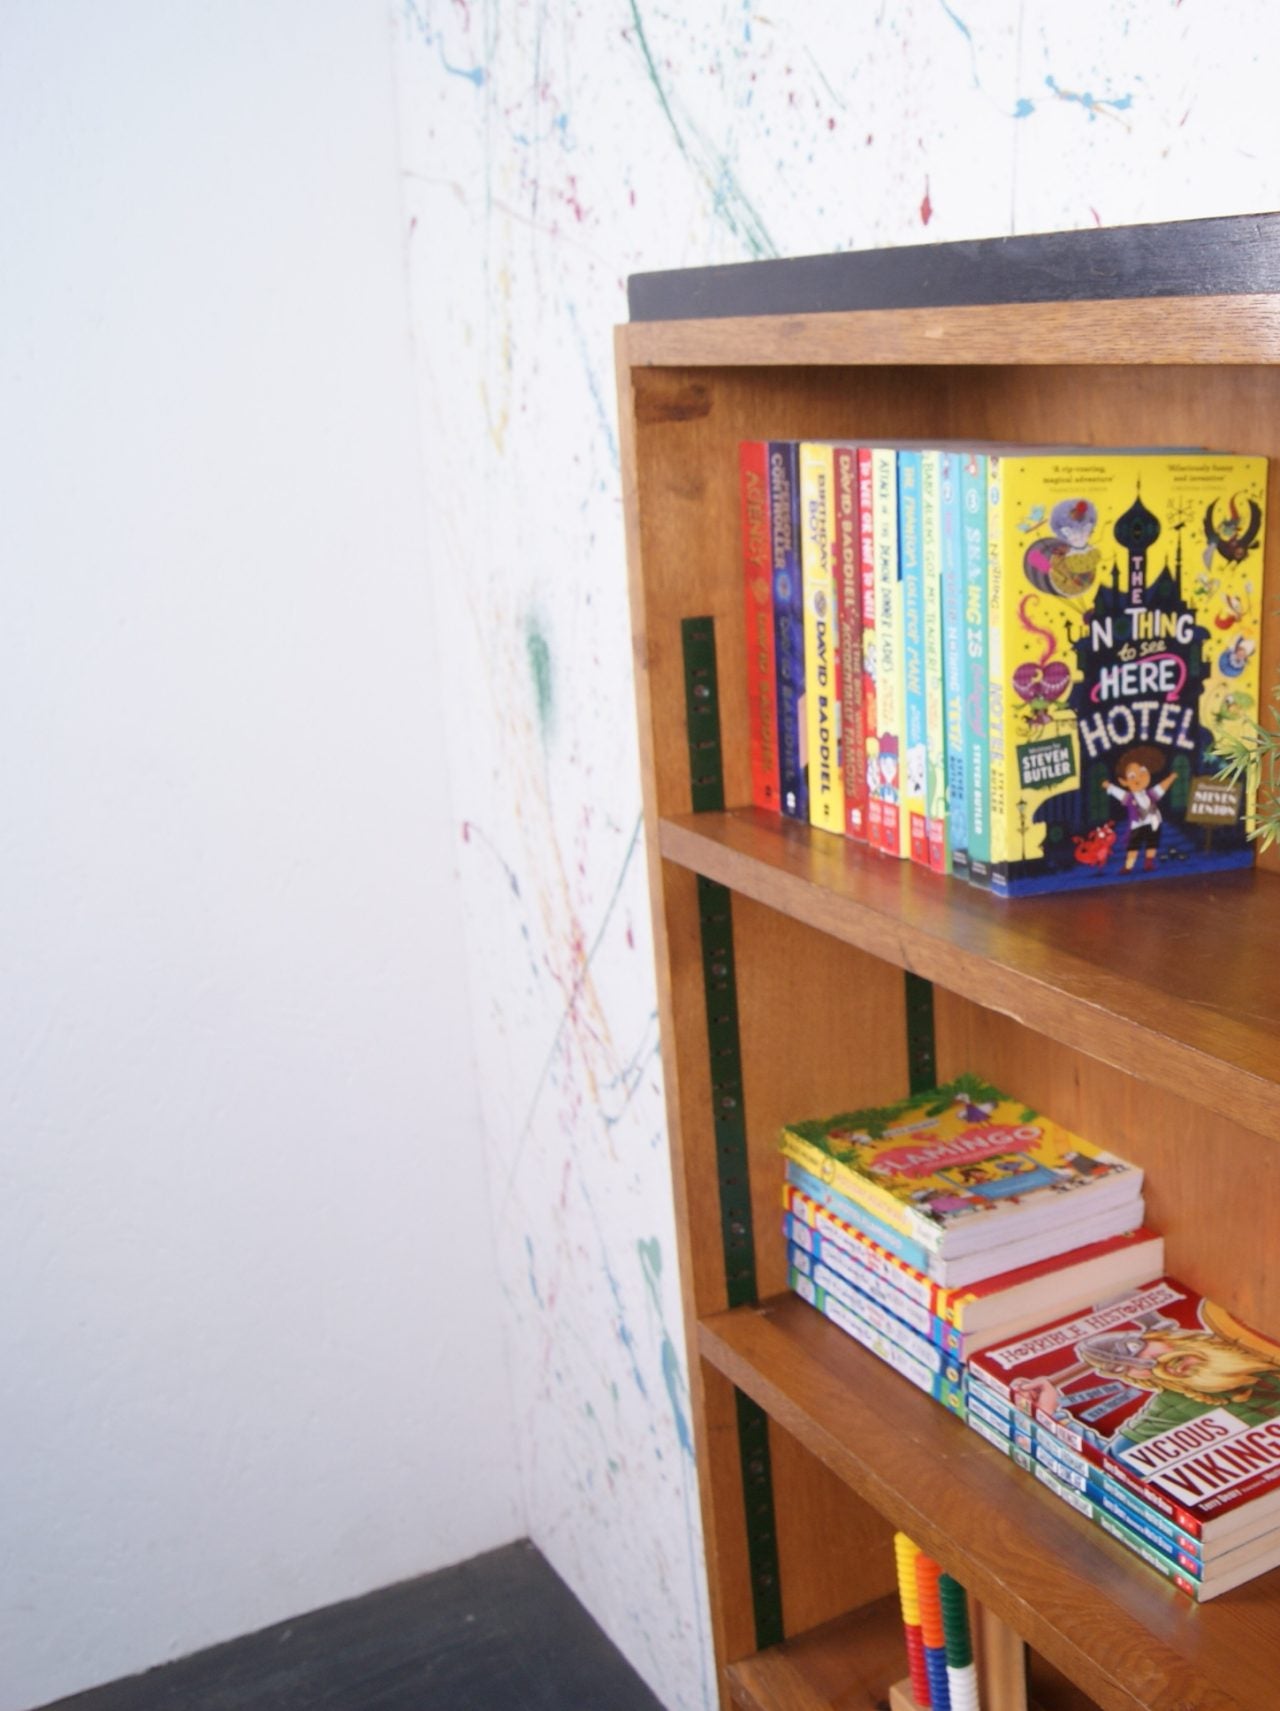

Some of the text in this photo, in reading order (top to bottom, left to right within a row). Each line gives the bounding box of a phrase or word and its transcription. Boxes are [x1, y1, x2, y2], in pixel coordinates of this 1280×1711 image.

[924, 462, 935, 496] BABY
[771, 453, 785, 569] CONTROLLER
[839, 455, 855, 608] DAVID BADDIEL
[925, 501, 935, 545] ALIENS
[880, 545, 891, 583] DEMON
[925, 550, 935, 578] GOT
[1132, 556, 1144, 604] THE
[881, 587, 892, 628] DINNER
[927, 586, 935, 605] MY
[968, 628, 983, 658] IS
[1092, 606, 1194, 653] NTHING
[1117, 640, 1168, 662] to see
[1100, 660, 1177, 700] HERE
[818, 621, 830, 795] DAVID BADDIEL
[1080, 701, 1196, 758] HOTEL
[1022, 748, 1070, 770] STEVEN
[1023, 762, 1072, 785] BUTLER
[972, 743, 983, 836] STEVEN BUTLER
[870, 1126, 1043, 1176] FLAMINGO
[999, 1287, 1175, 1364] HORRIBLE HISTORIES
[1128, 1417, 1230, 1469] VICIOUS
